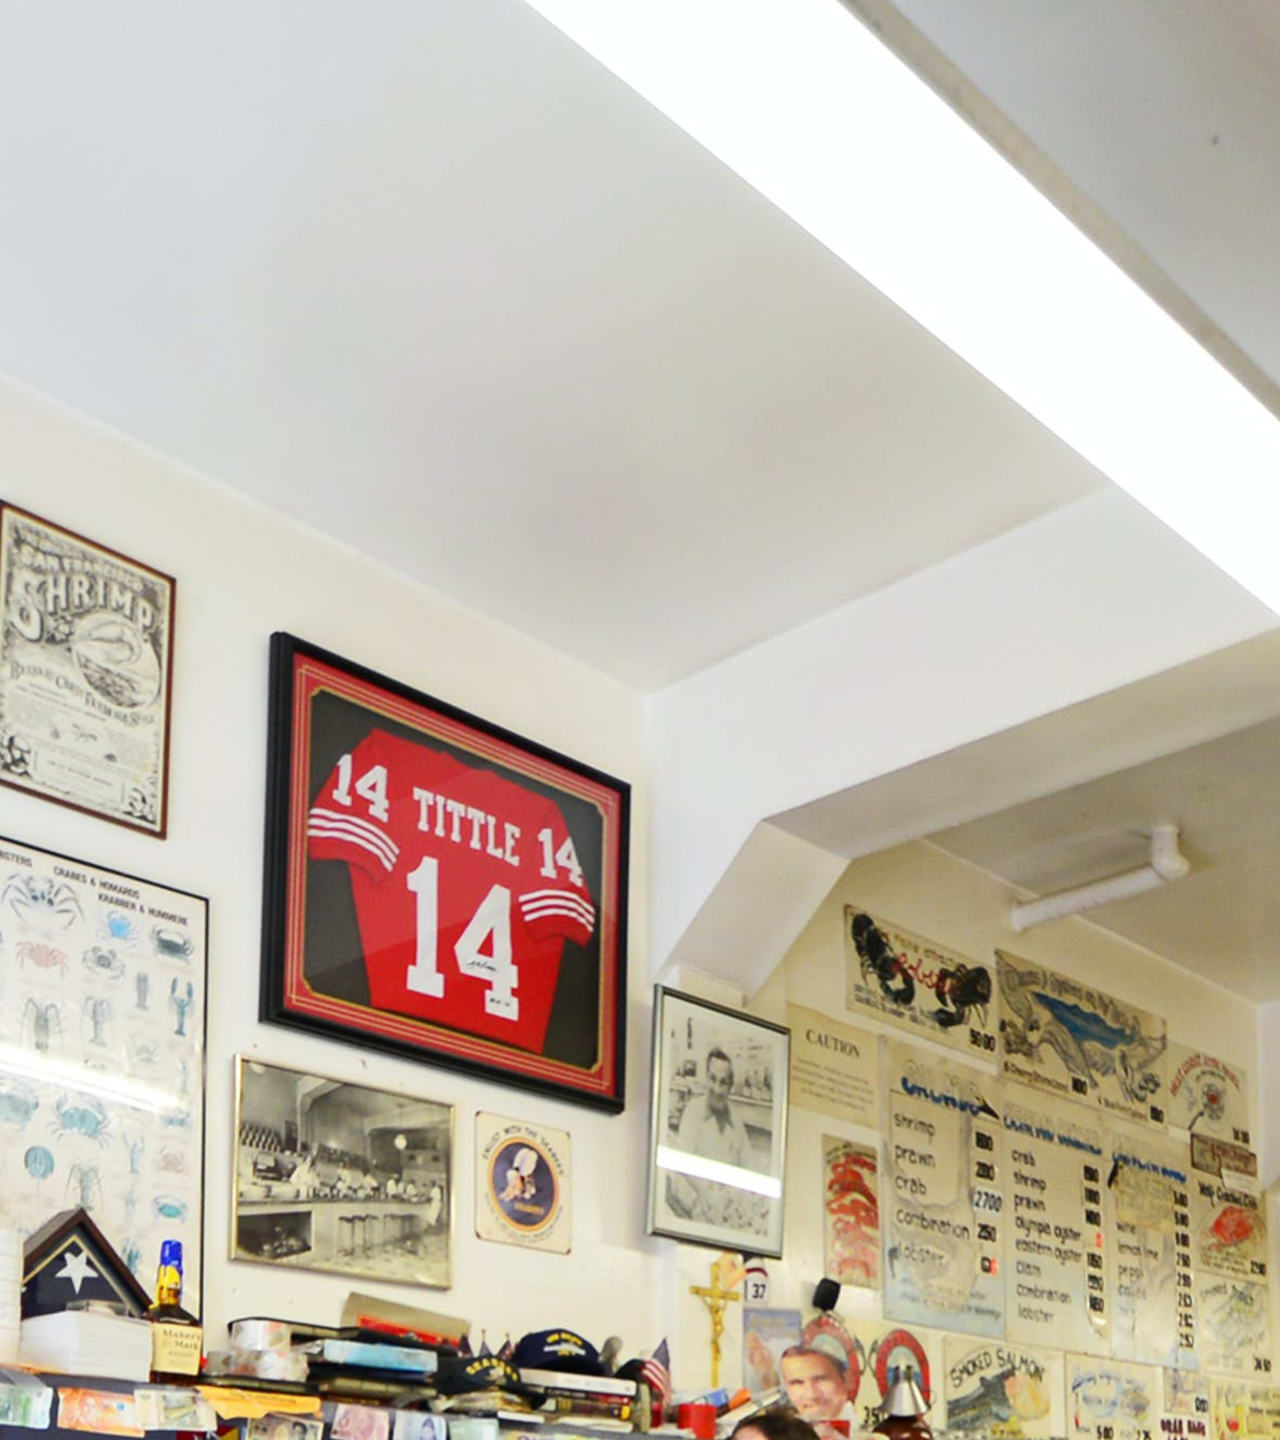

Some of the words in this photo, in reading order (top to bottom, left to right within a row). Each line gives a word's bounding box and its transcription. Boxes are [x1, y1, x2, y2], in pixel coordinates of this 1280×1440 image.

[9, 567, 155, 643] SHRIMP
[331, 753, 389, 822] 14
[412, 786, 521, 867] TITTLE
[536, 827, 584, 887] 14
[406, 856, 519, 1022] 14
[805, 1029, 860, 1058] CAUTION
[950, 1351, 993, 1389] SMOKED
[996, 1348, 1045, 1382] SALMON
